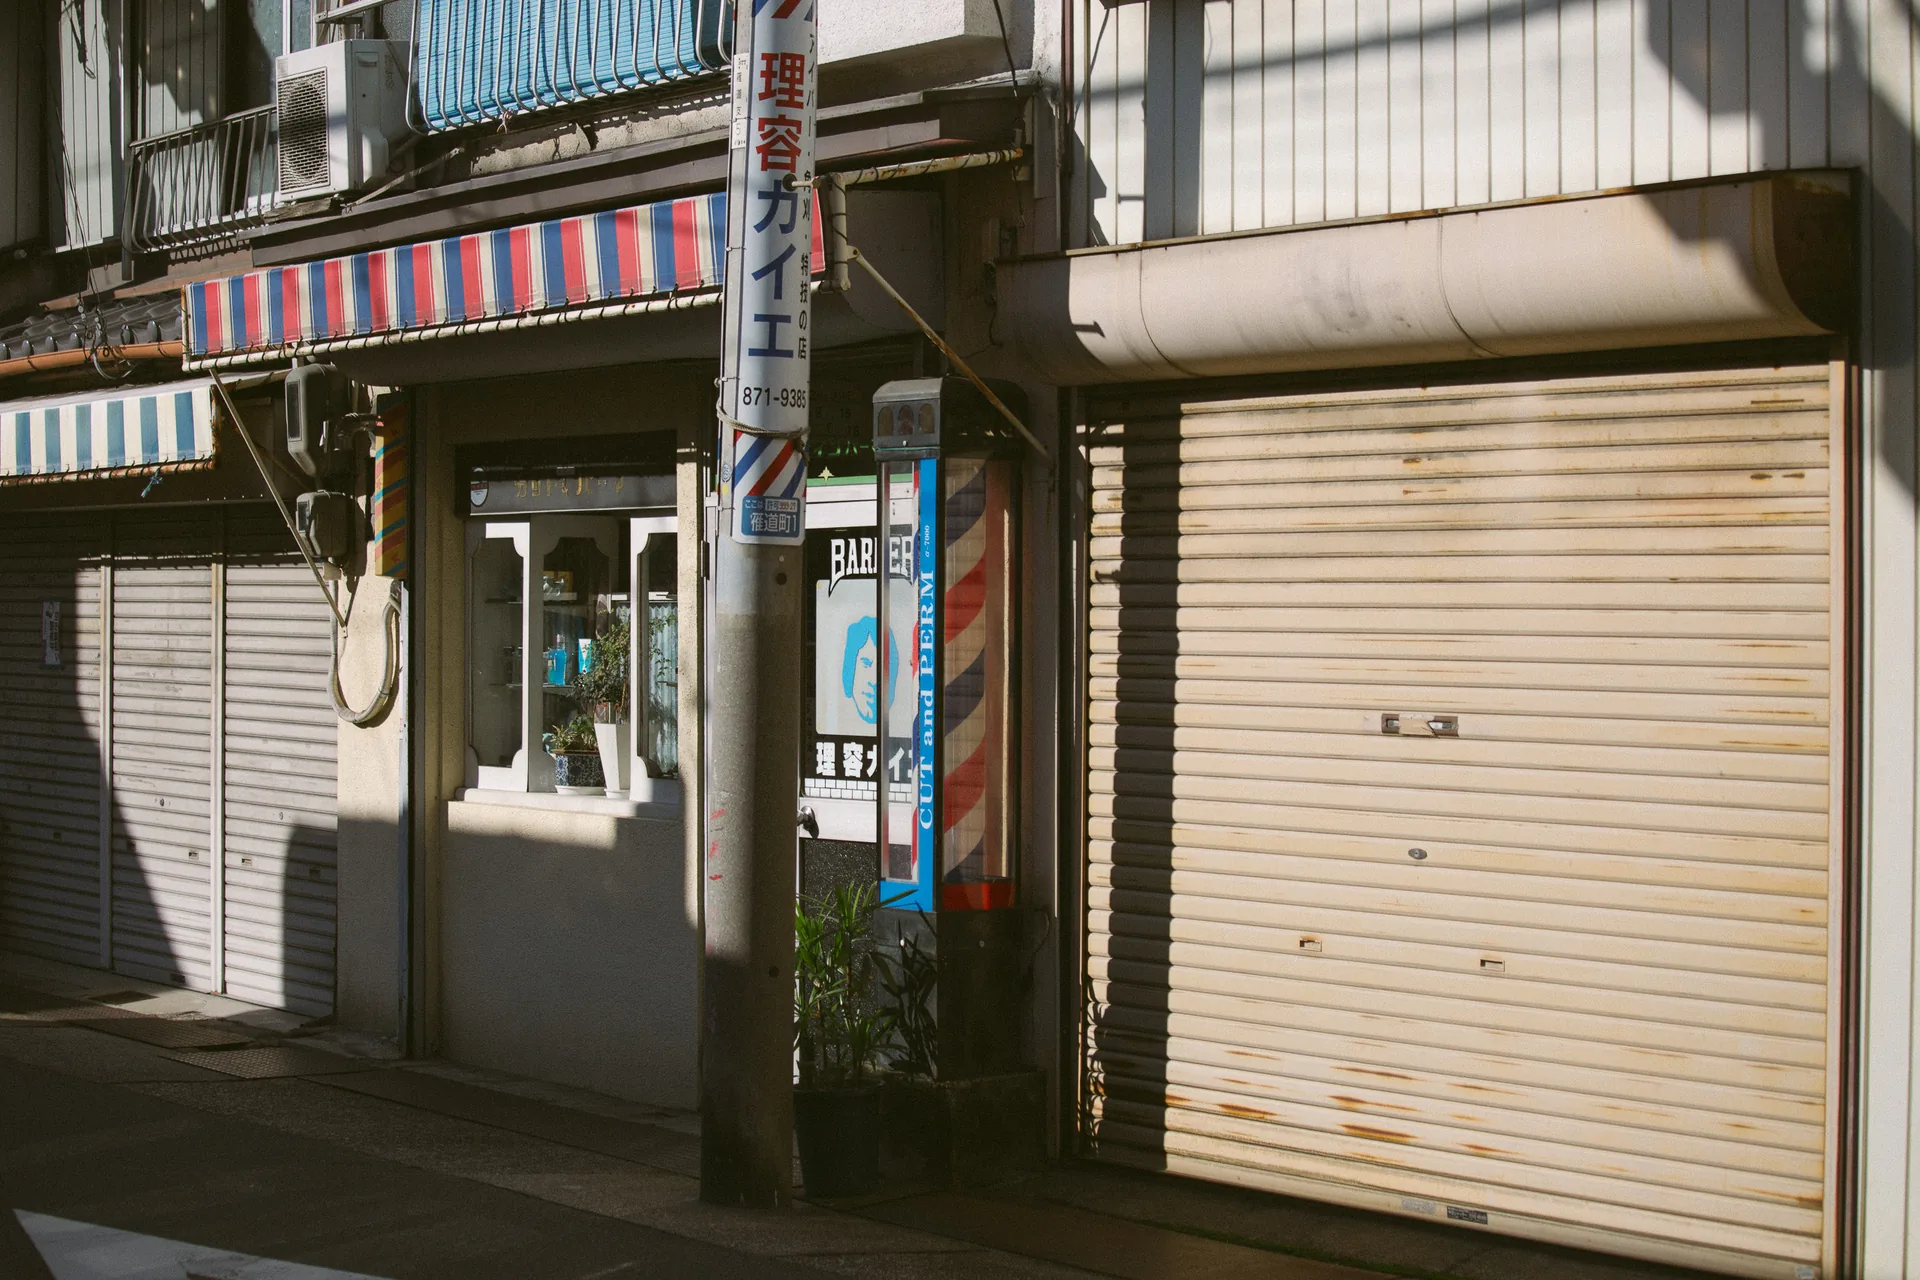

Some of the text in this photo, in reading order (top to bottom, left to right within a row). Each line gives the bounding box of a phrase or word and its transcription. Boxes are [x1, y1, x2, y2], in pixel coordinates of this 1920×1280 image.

[743, 386, 806, 408] 871-9385
[829, 536, 914, 592] BARER
[920, 570, 934, 677] PERM
[920, 689, 934, 747] and
[816, 742, 912, 781] 理容カイ
[920, 756, 934, 830] CUT
